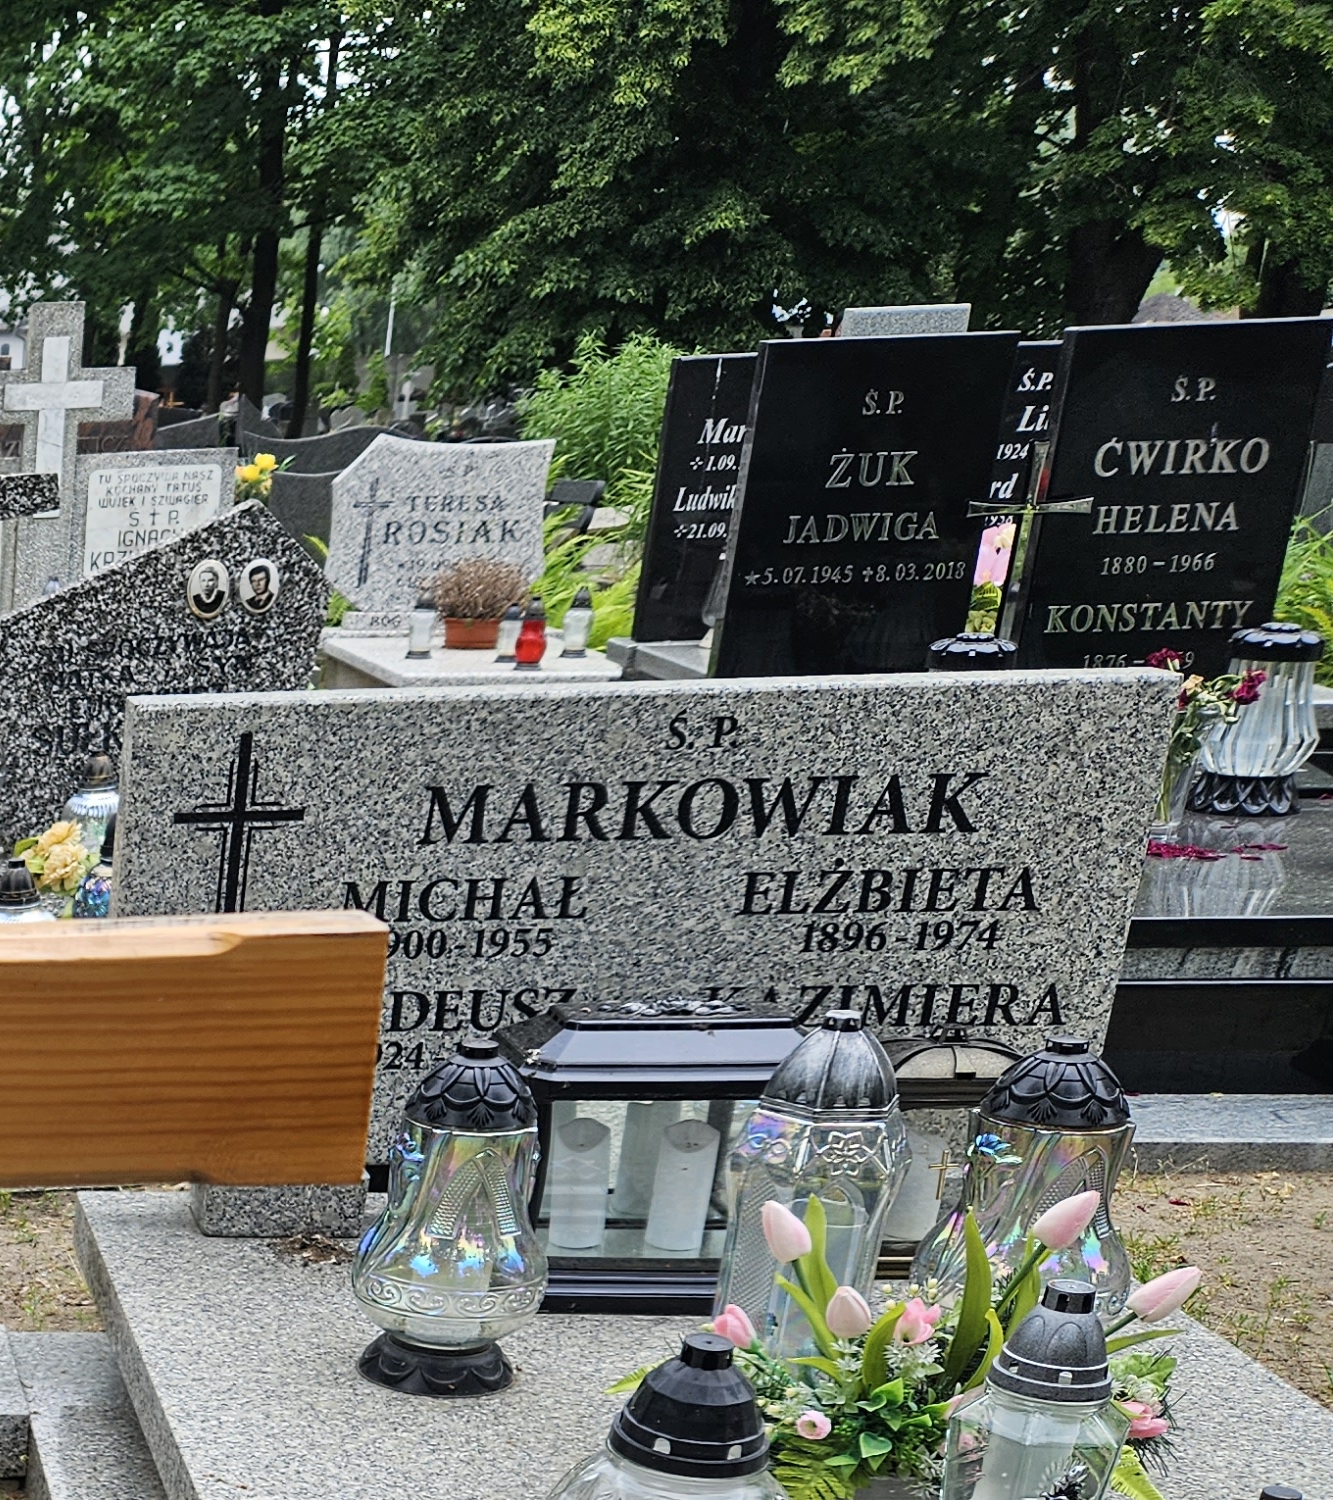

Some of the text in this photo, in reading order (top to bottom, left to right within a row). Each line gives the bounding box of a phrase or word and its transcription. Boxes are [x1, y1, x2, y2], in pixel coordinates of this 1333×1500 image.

[1015, 404, 1050, 434] Li
[705, 453, 741, 472] 1.09.
[824, 447, 919, 489] ŻUK
[1093, 436, 1271, 479] ĆWIRKO
[183, 469, 215, 481] NASZ
[98, 496, 137, 509] WUJEK
[151, 493, 209, 506] SZWAGIER
[406, 494, 508, 514] TERESA
[382, 519, 529, 547] ROSIAK
[782, 511, 940, 544] JADWIGA
[1092, 501, 1240, 536] HELENA
[117, 529, 179, 548] IGNAC
[1044, 600, 1254, 634] KONSTANTY
[416, 771, 990, 846] MARKOWIAK
[342, 875, 588, 923] MICHAŁ
[738, 857, 1041, 917] ELŻBIETA
[386, 927, 555, 960] 900-1955
[378, 987, 579, 1033] DEUSZ
